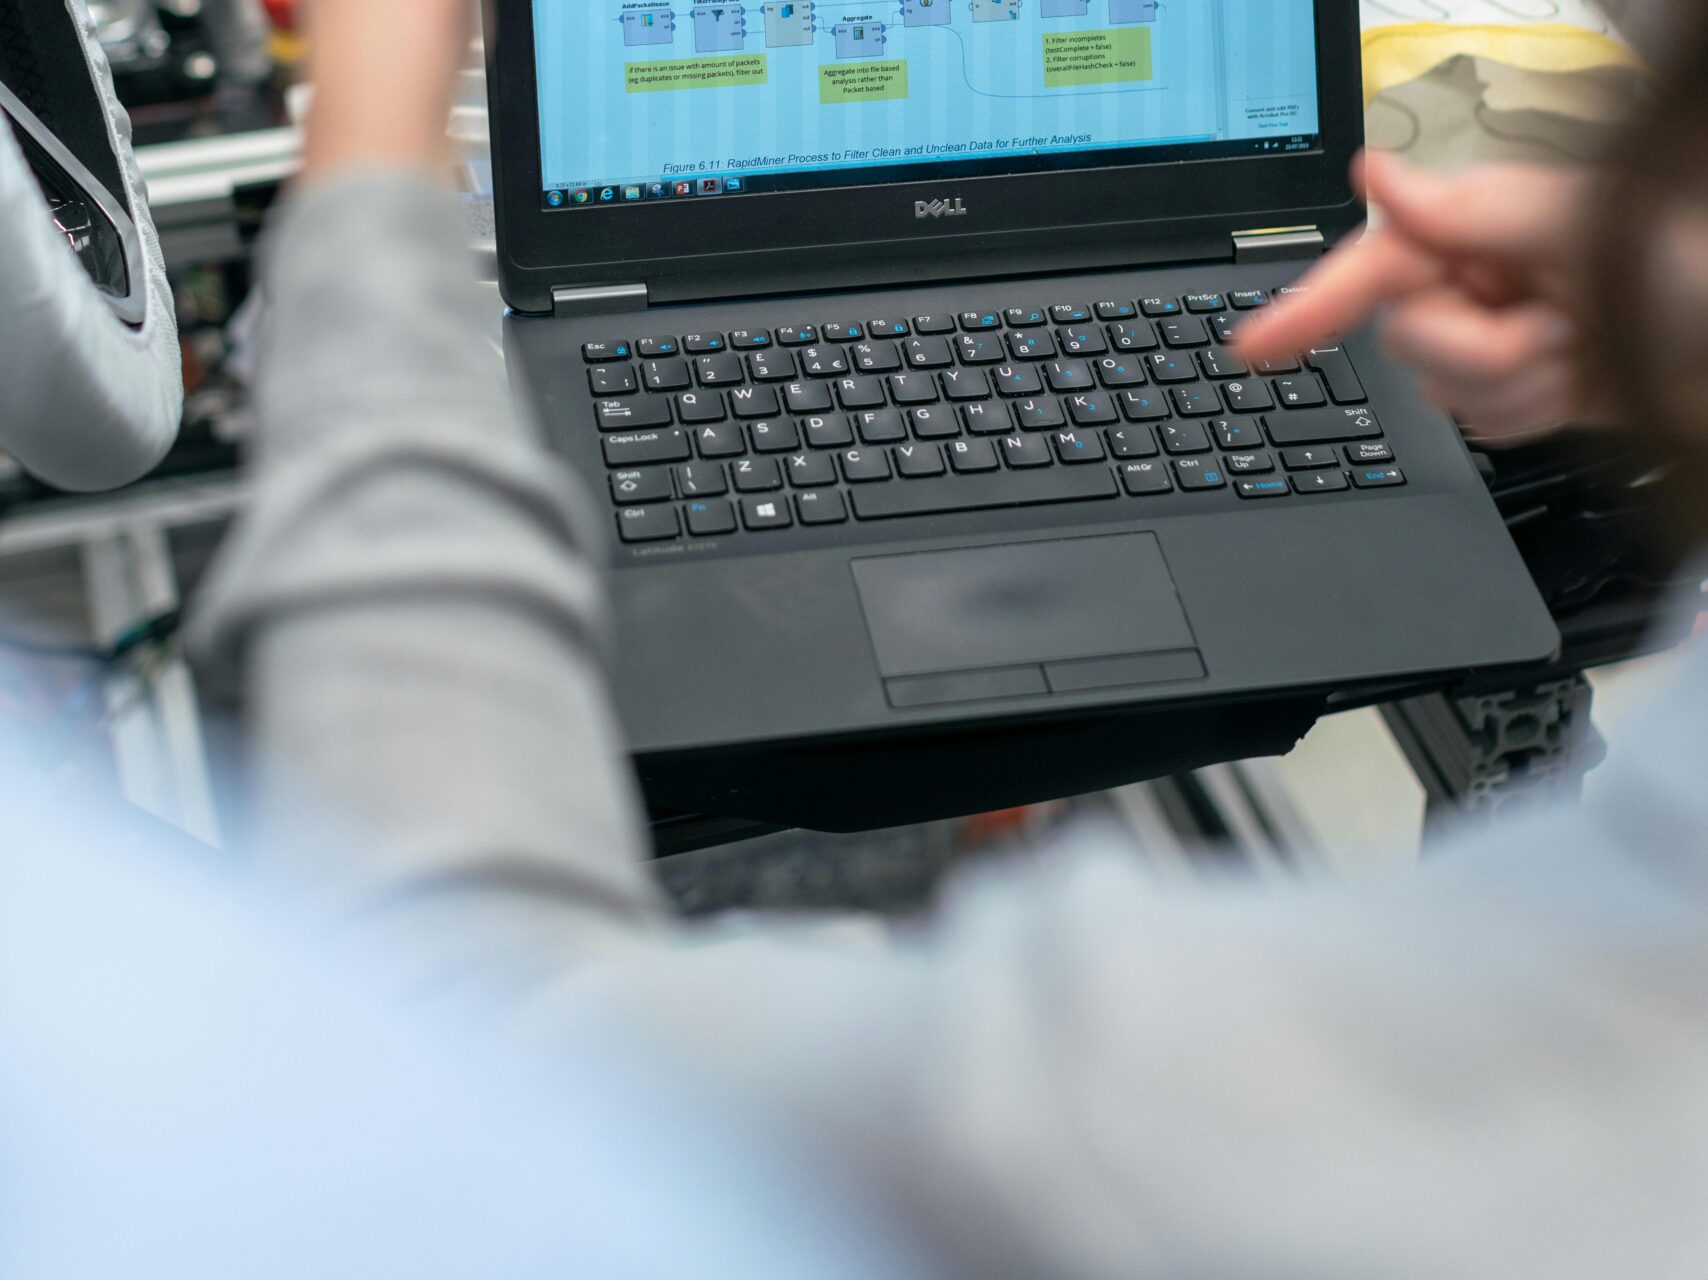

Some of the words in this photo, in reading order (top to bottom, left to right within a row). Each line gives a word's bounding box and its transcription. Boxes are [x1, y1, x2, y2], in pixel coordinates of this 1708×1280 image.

[1046, 46, 1089, 54] (testComplete
[736, 59, 760, 67] packets
[824, 69, 855, 77] Aggregate
[629, 76, 638, 84] (eg
[640, 74, 672, 83] duplicates
[682, 72, 706, 80] missing
[663, 163, 695, 175] Figure
[699, 160, 724, 171] 6.11:
[727, 155, 785, 169] RapidMiner
[788, 153, 829, 164] Process
[831, 151, 841, 160] to
[843, 149, 869, 159] Filter
[872, 146, 901, 158] Clean
[904, 145, 923, 155] and
[926, 142, 966, 153] Unclean
[969, 140, 993, 150] Data
[995, 139, 1009, 148] for
[1012, 136, 1048, 147] Further
[1050, 133, 1091, 144] Analysis
[914, 197, 968, 218] DELL
[1188, 294, 1218, 302] PrtScr
[1234, 289, 1261, 298] Insert
[1019, 345, 1029, 353] 8
[1070, 341, 1080, 349] 9
[916, 354, 926, 362] 6
[967, 350, 976, 358] 7
[864, 358, 873, 366] 5
[1102, 359, 1116, 368] O
[1154, 354, 1165, 364] P
[812, 362, 821, 370] 4
[1055, 363, 1060, 372] I
[706, 371, 715, 379] 2
[759, 367, 768, 375] 3
[947, 371, 959, 380] Y
[1000, 367, 1012, 377] U
[842, 380, 855, 389] R
[895, 375, 906, 385] T
[790, 384, 802, 394] E
[683, 393, 697, 404] Q
[734, 389, 752, 399] W
[1128, 392, 1139, 401] L
[1024, 400, 1034, 411] J
[1074, 396, 1088, 406] K
[917, 409, 930, 419] G
[969, 404, 983, 415] H
[1345, 408, 1368, 416] Shift
[864, 413, 875, 423] F
[810, 418, 824, 428] D
[703, 428, 715, 437] A
[757, 423, 768, 433] S
[609, 434, 634, 444] Caps
[635, 432, 658, 441] Lock
[1007, 437, 1022, 448] N
[1059, 433, 1076, 444] M
[901, 446, 913, 457] V
[955, 442, 968, 452] B
[847, 451, 860, 462] C
[1360, 450, 1387, 458] Down
[793, 455, 807, 466] X
[1180, 459, 1199, 467] Ctrl
[1232, 455, 1255, 463] Page
[739, 461, 752, 472] Z
[616, 472, 640, 480] Shift
[1366, 472, 1385, 480] End
[1255, 481, 1284, 489] Home
[803, 492, 817, 501] Alt
[691, 503, 707, 511] Fn
[624, 509, 645, 518] Ctrl
